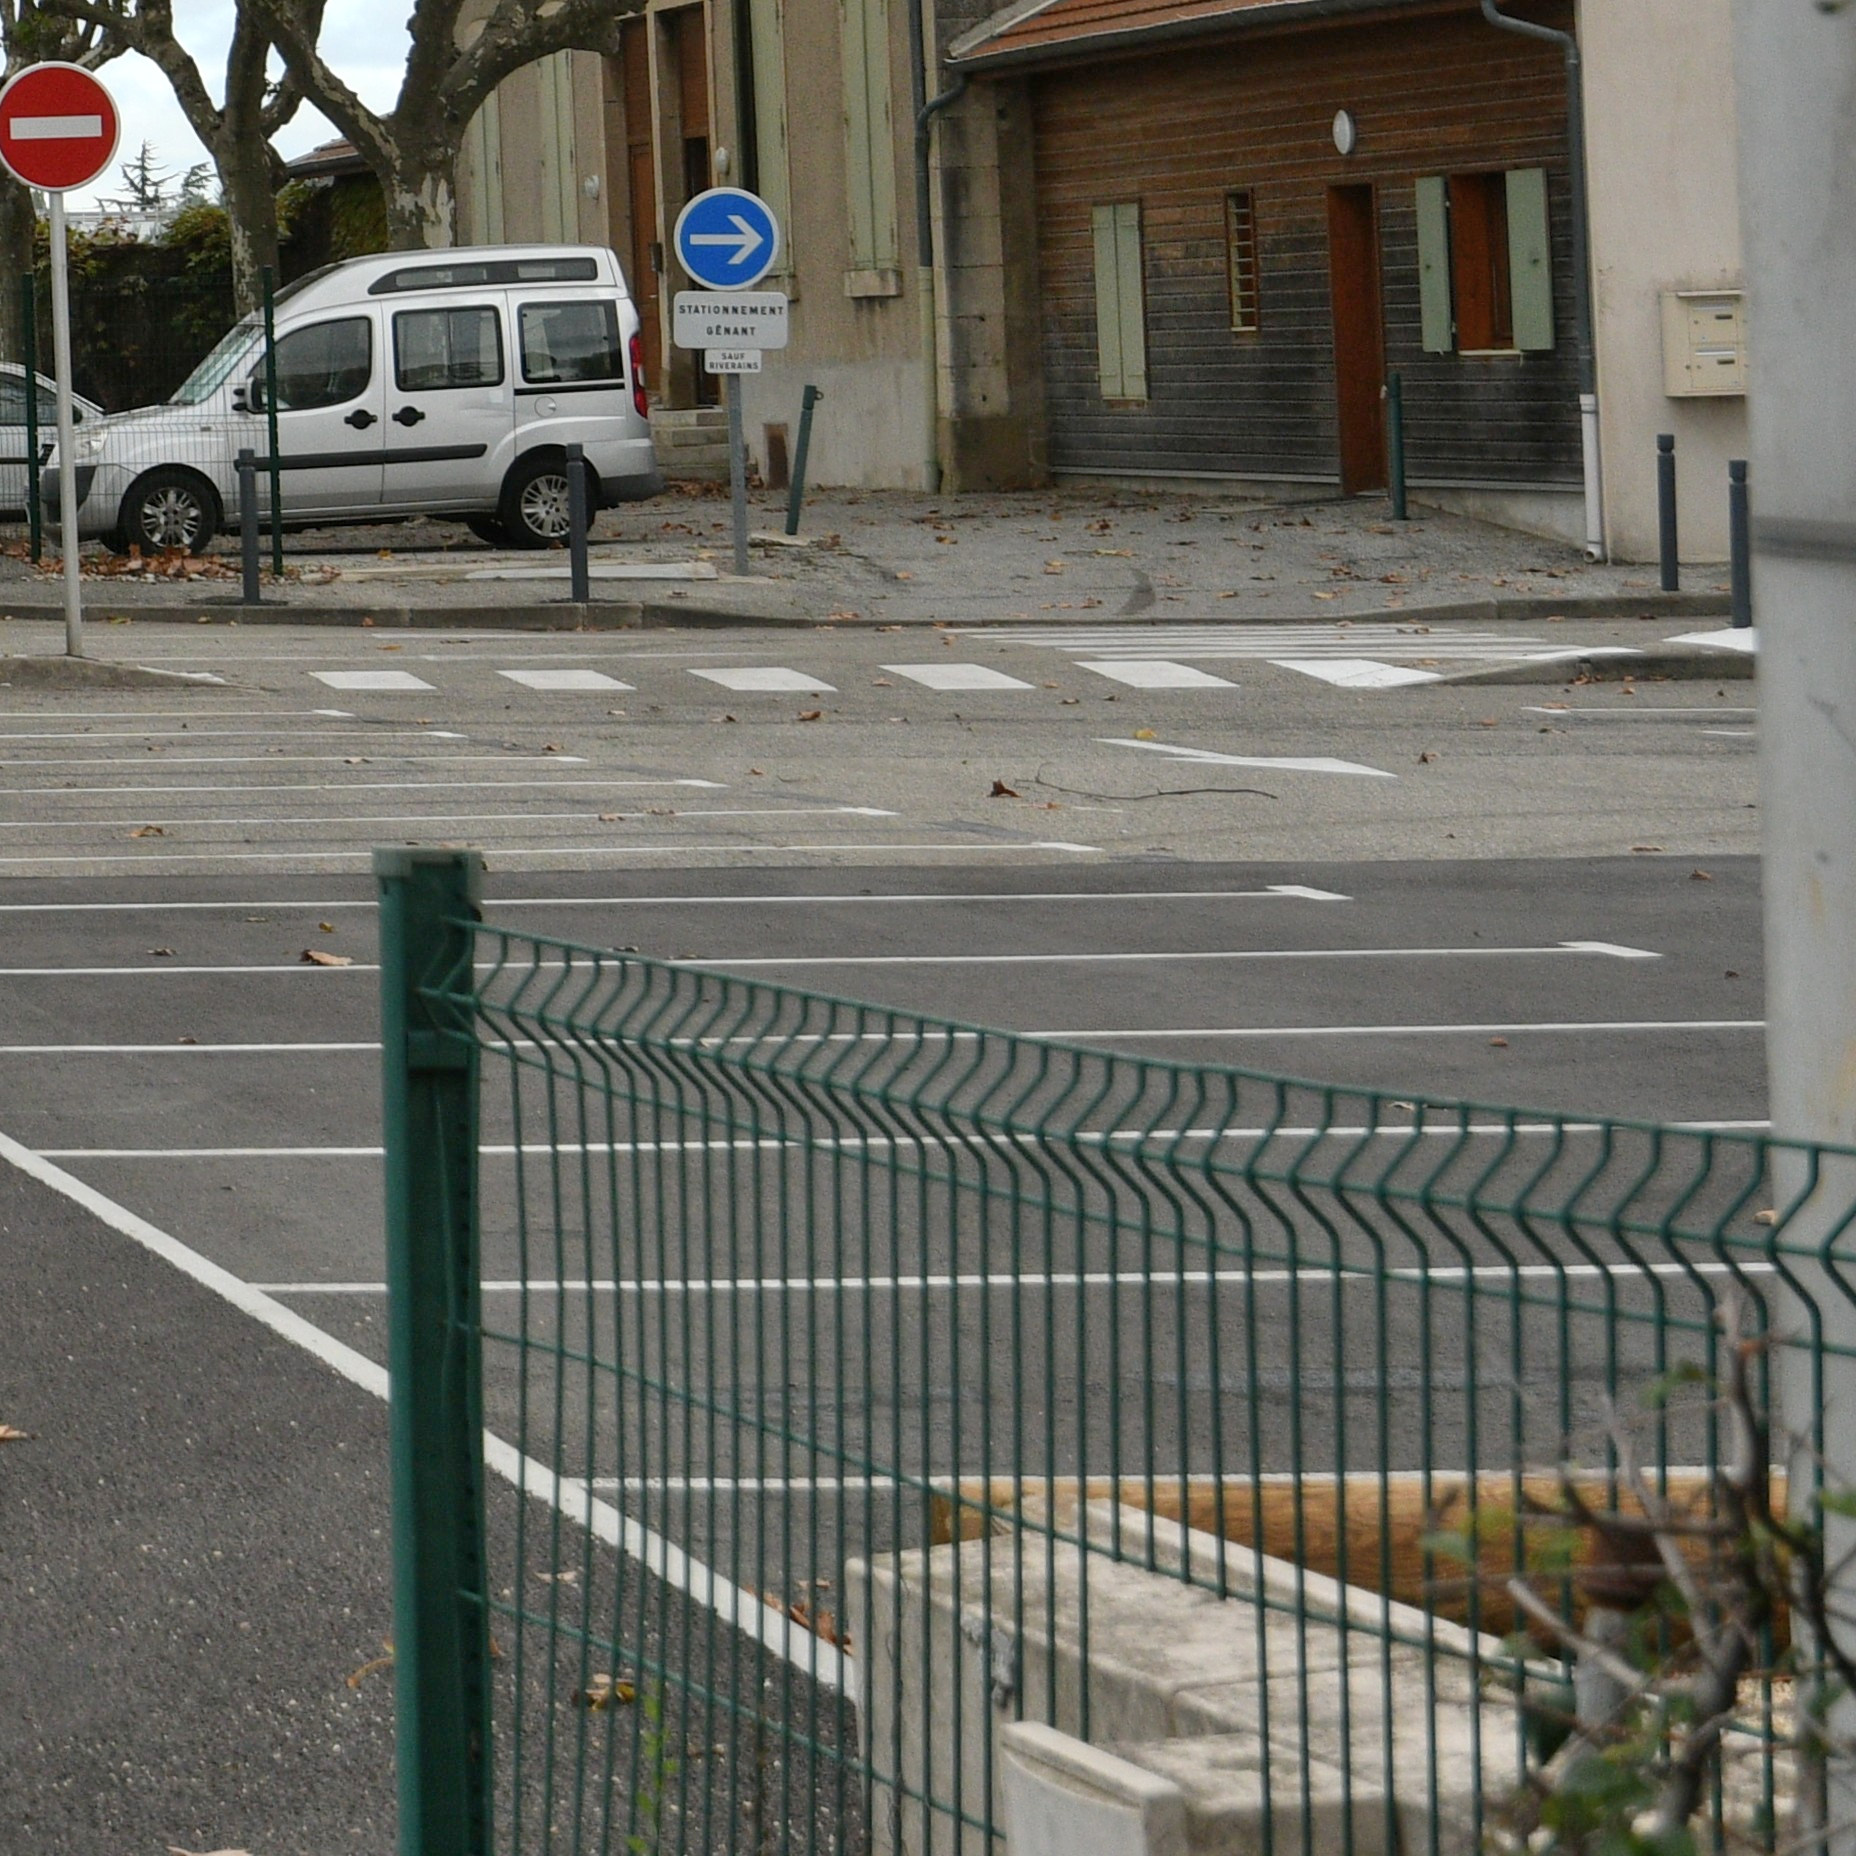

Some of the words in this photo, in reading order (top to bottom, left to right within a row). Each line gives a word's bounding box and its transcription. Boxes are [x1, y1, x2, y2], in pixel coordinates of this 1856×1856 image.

[679, 304, 784, 316] STATIONNEMENT
[706, 324, 756, 336] GÊNANT
[721, 352, 745, 361] SAUF
[709, 361, 759, 371] RIVERAINS
